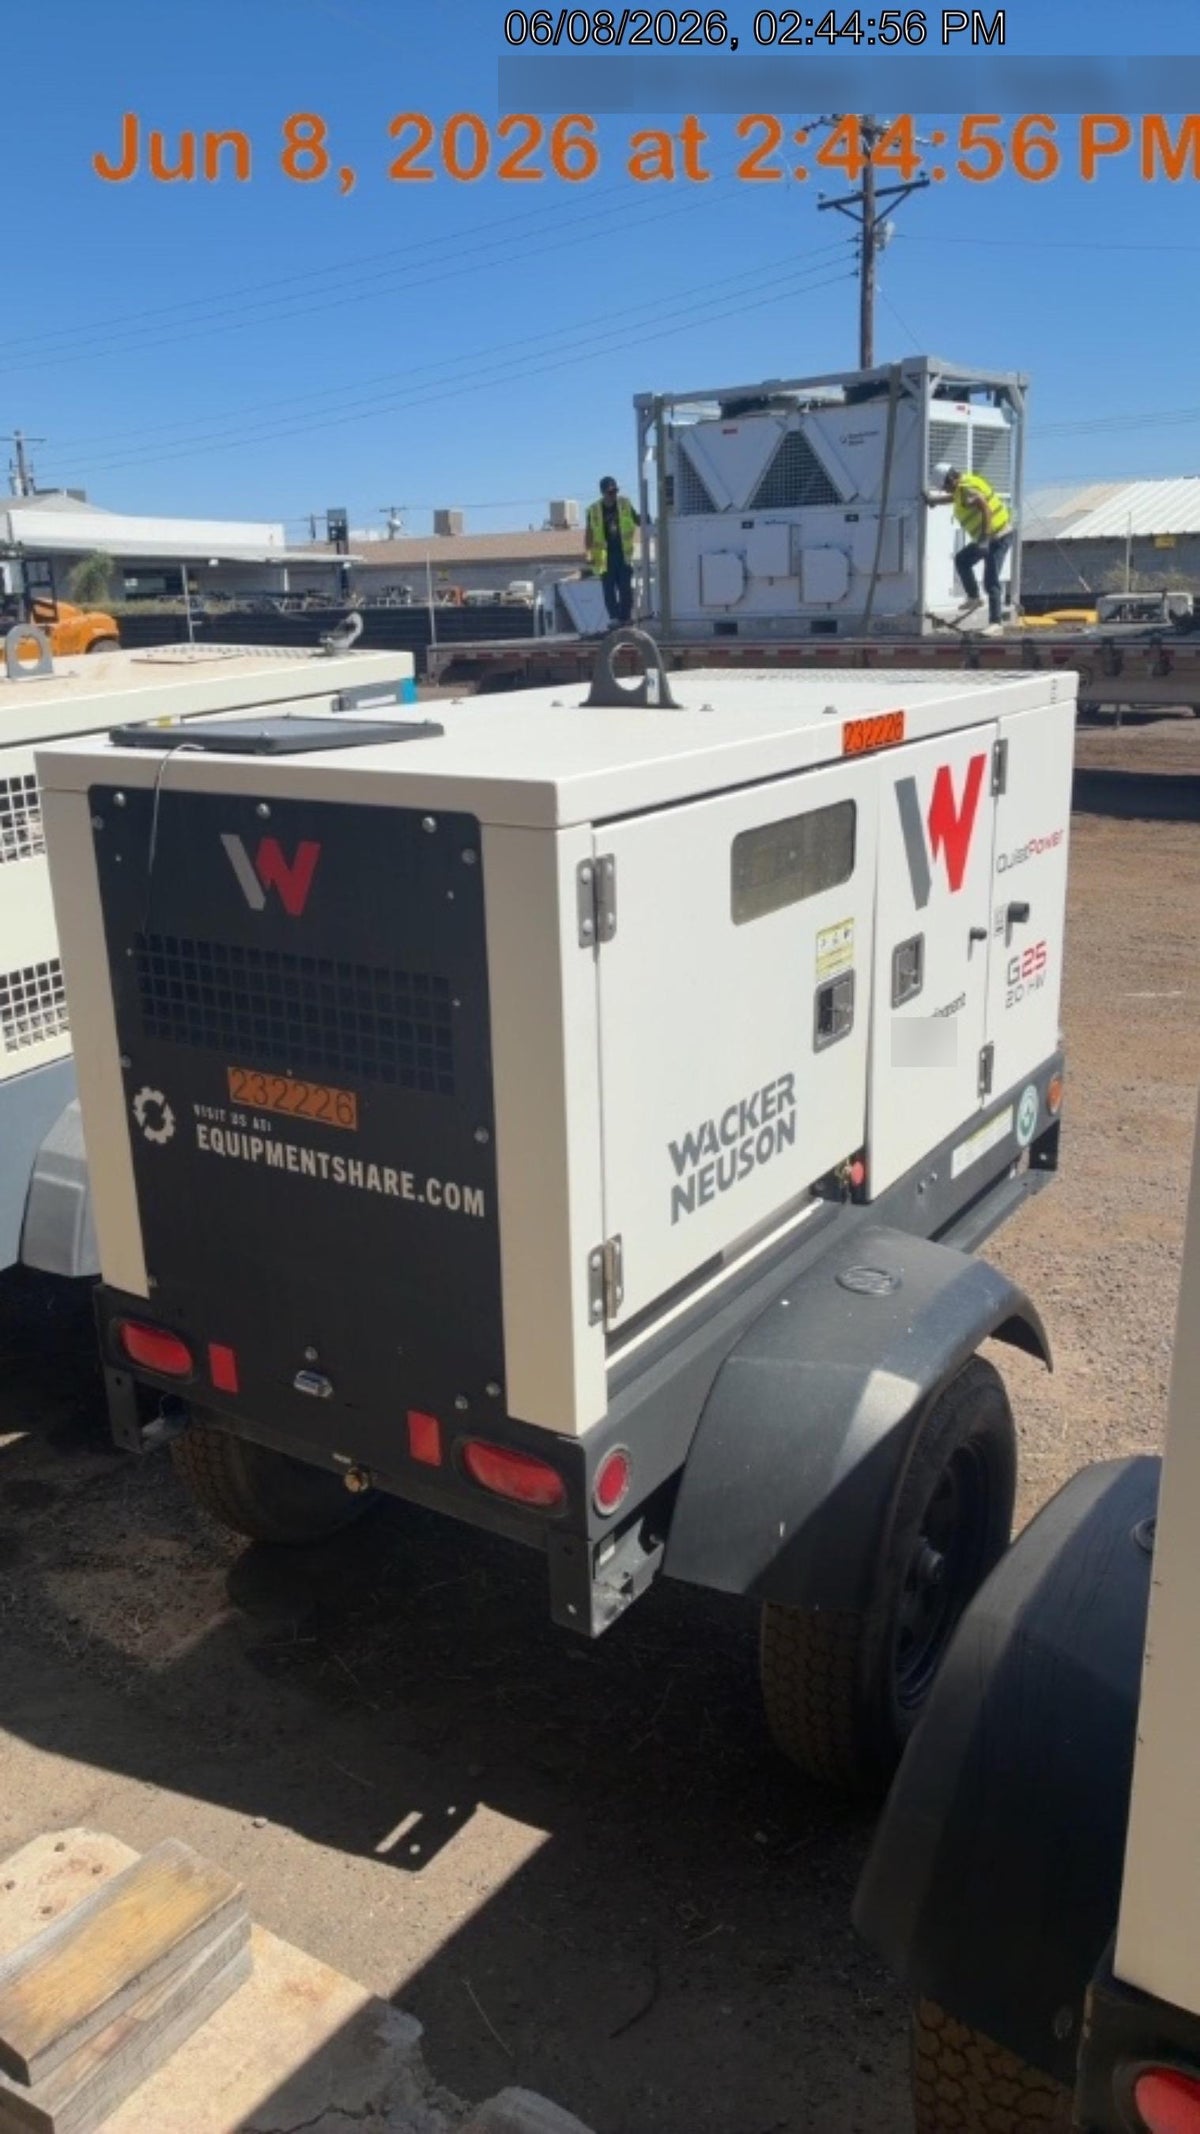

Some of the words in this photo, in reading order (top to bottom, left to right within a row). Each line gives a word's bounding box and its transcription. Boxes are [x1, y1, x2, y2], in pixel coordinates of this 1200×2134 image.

[1007, 940, 1047, 987] G25
[193, 1103, 226, 1122] VISIT
[230, 1111, 247, 1128] US
[231, 1068, 354, 1125] 232226
[667, 1072, 795, 1177] WACKER
[196, 1123, 486, 1218] EQUIPMENTSHARE.COM
[670, 1109, 796, 1226] NEUSON
